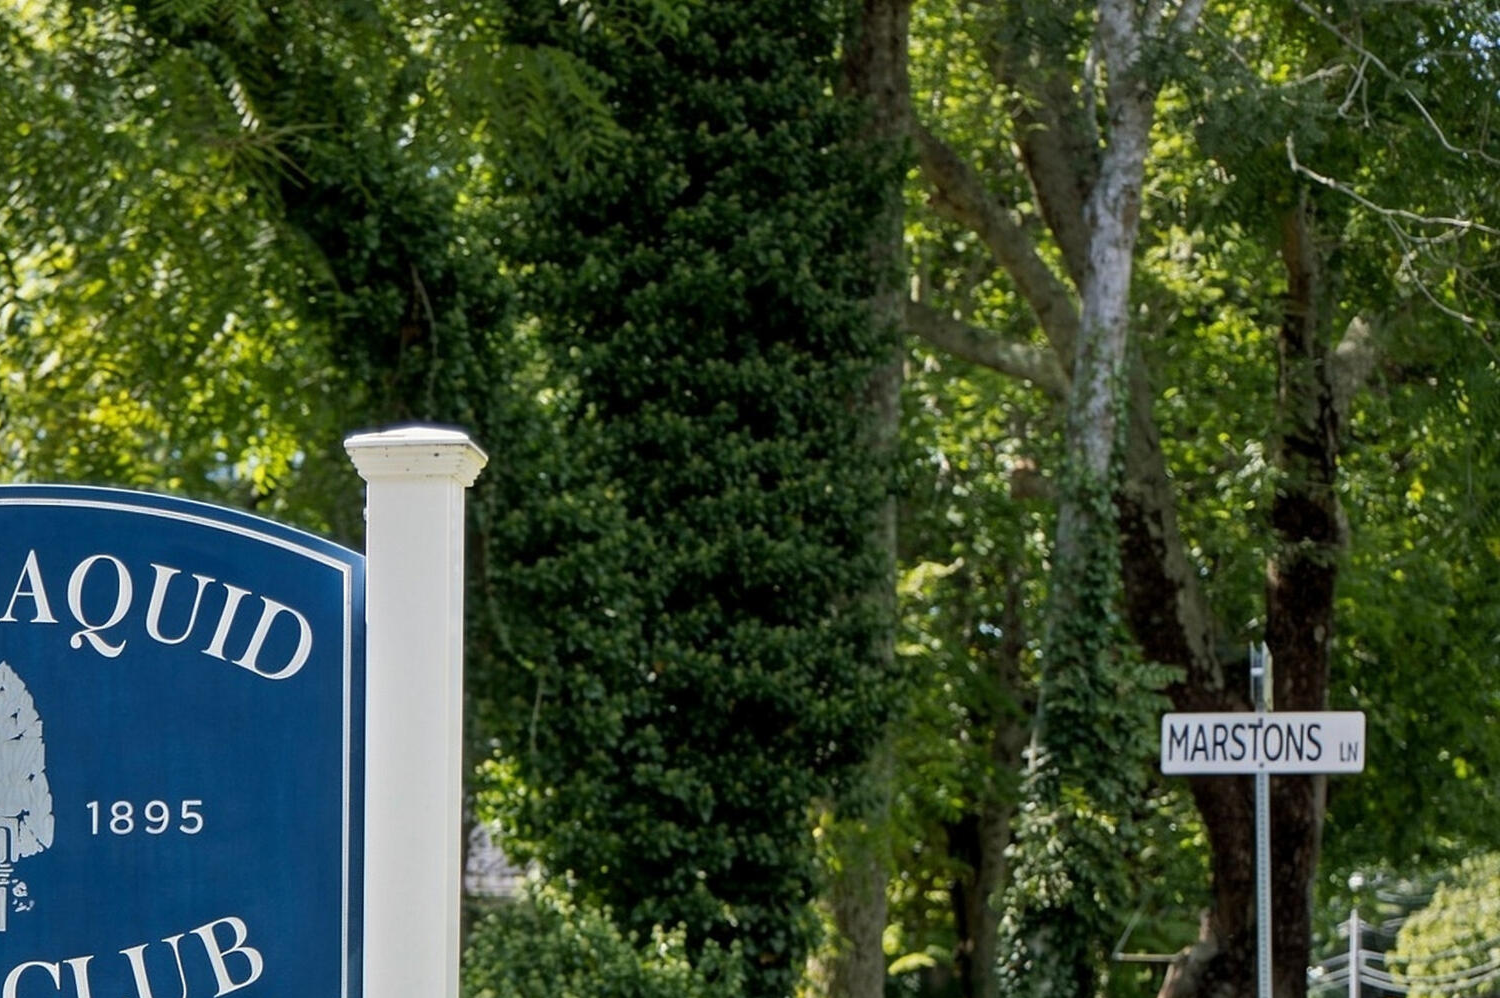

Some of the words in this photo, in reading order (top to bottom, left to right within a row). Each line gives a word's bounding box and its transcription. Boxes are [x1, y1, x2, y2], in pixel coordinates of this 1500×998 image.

[1168, 723, 1322, 762] MARSTONS
[1339, 741, 1358, 762] LN
[86, 799, 204, 835] 1895
